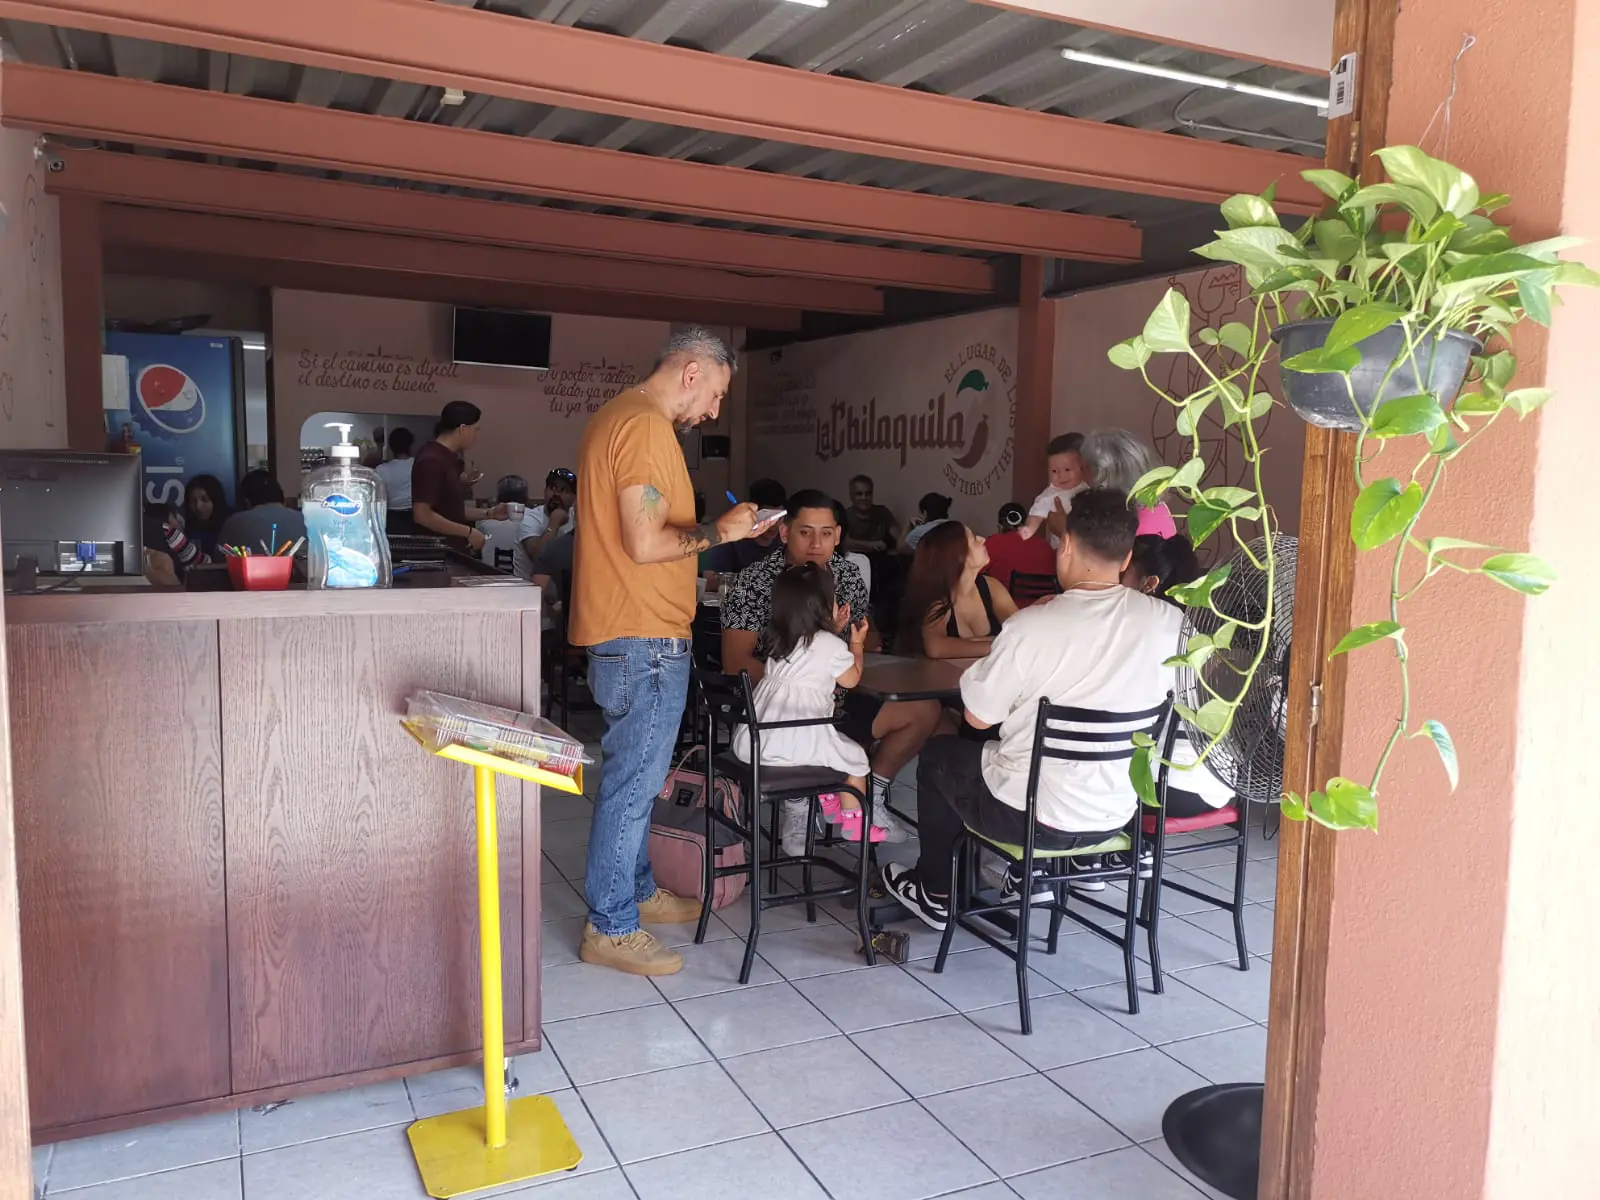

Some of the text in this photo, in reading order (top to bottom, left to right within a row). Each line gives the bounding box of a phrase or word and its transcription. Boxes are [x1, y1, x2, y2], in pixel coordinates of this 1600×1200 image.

[298, 348, 318, 369] Si
[322, 351, 338, 370] el
[340, 359, 394, 374] camino
[396, 363, 411, 375] es
[958, 343, 996, 366] LUGAR
[316, 369, 370, 390] destino
[372, 379, 388, 391] es
[560, 369, 594, 385] poder
[600, 369, 635, 384] radica
[944, 361, 959, 384] EL
[997, 356, 1012, 383] DE
[830, 391, 966, 470] Chilaquila
[942, 437, 1015, 496] CHILAQUILES
